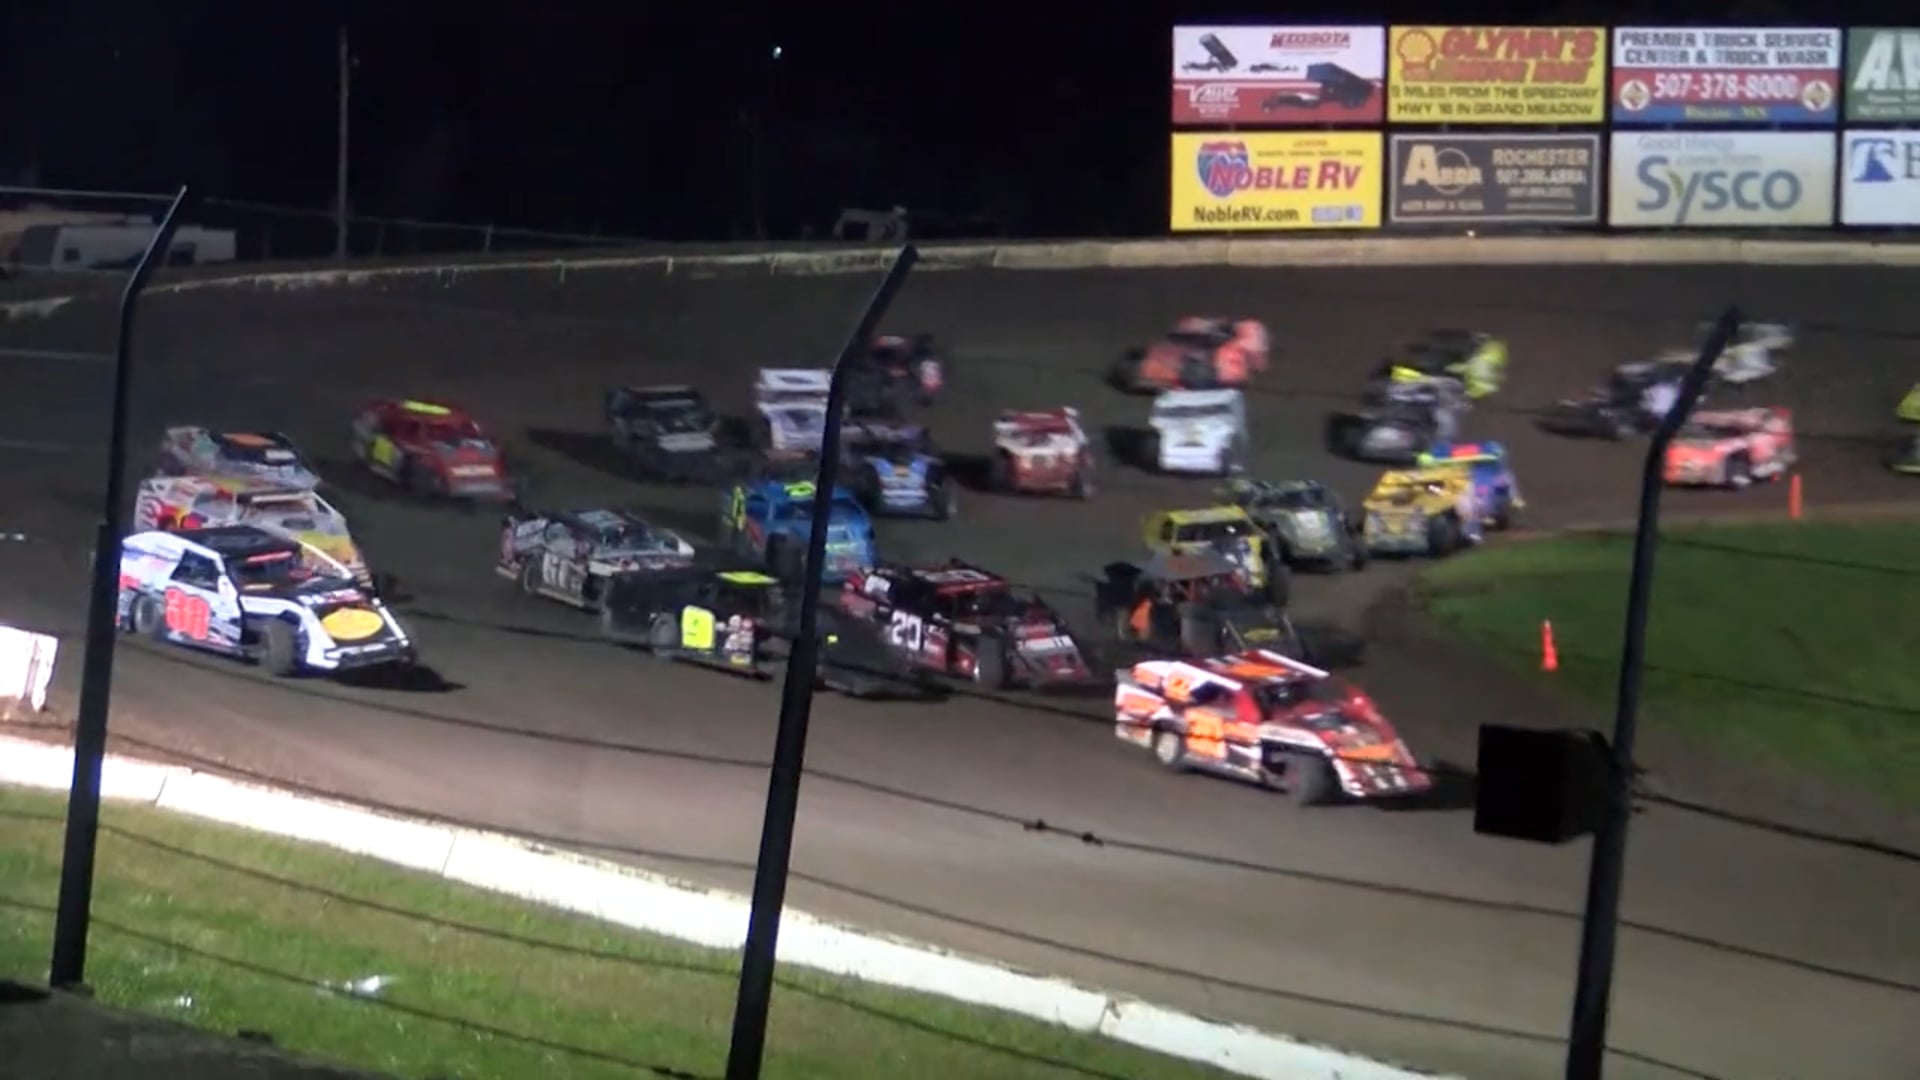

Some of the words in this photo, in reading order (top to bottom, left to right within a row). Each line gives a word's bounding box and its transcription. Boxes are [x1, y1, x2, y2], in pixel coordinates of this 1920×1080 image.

[1621, 32, 1695, 46] PREMIER
[1703, 33, 1757, 46] TRUCK
[1764, 34, 1833, 47] SERVICE
[1624, 50, 1688, 63] CENTER
[1695, 50, 1708, 63] &
[1716, 51, 1768, 64] TRUCK
[1776, 51, 1829, 64] WASH
[1405, 86, 1446, 97] MILES
[1450, 86, 1490, 98] FROM
[1494, 87, 1519, 98] THE
[1522, 87, 1599, 98] SPEEDWAY
[1653, 72, 1799, 99] 507-378-8000
[1398, 103, 1433, 114] HWY
[1456, 103, 1470, 114] IN
[1474, 103, 1524, 115] GRAND
[1527, 104, 1593, 115] MEADOW
[1493, 149, 1588, 165] ROCHESTER
[1209, 161, 1310, 190] NOBLE
[1317, 161, 1361, 189] RV
[1195, 206, 1299, 222] NobleRV.com
